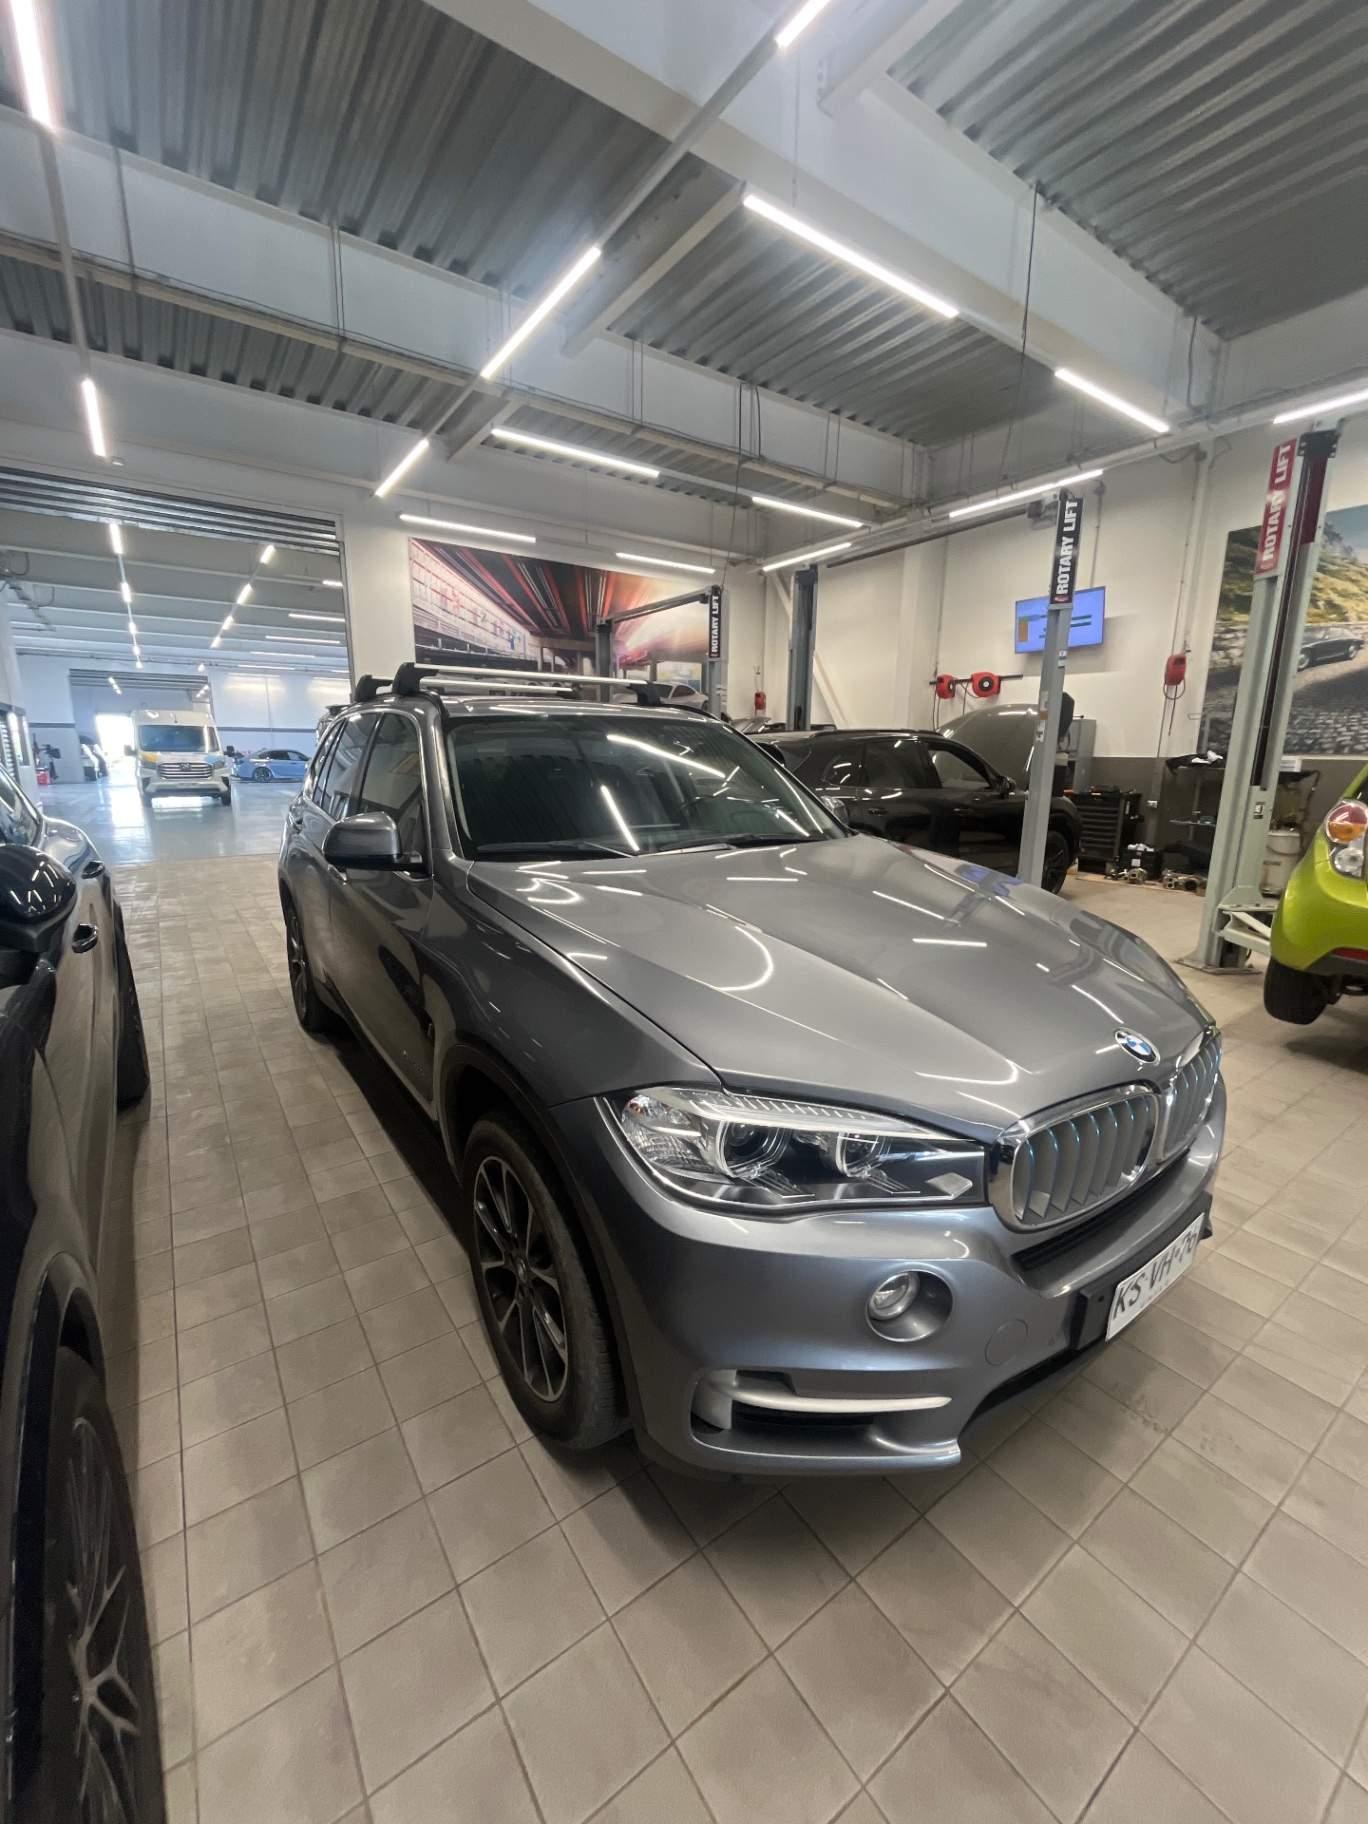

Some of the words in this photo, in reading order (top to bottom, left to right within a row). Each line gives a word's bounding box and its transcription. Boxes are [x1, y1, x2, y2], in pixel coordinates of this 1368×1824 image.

[1063, 500, 1078, 532] LIFT
[1262, 489, 1285, 561] ROTARY
[1274, 444, 1291, 484] LIFT
[1056, 536, 1074, 595] ROTARY
[711, 595, 719, 614] LIFT
[711, 616, 719, 652] ROTARY
